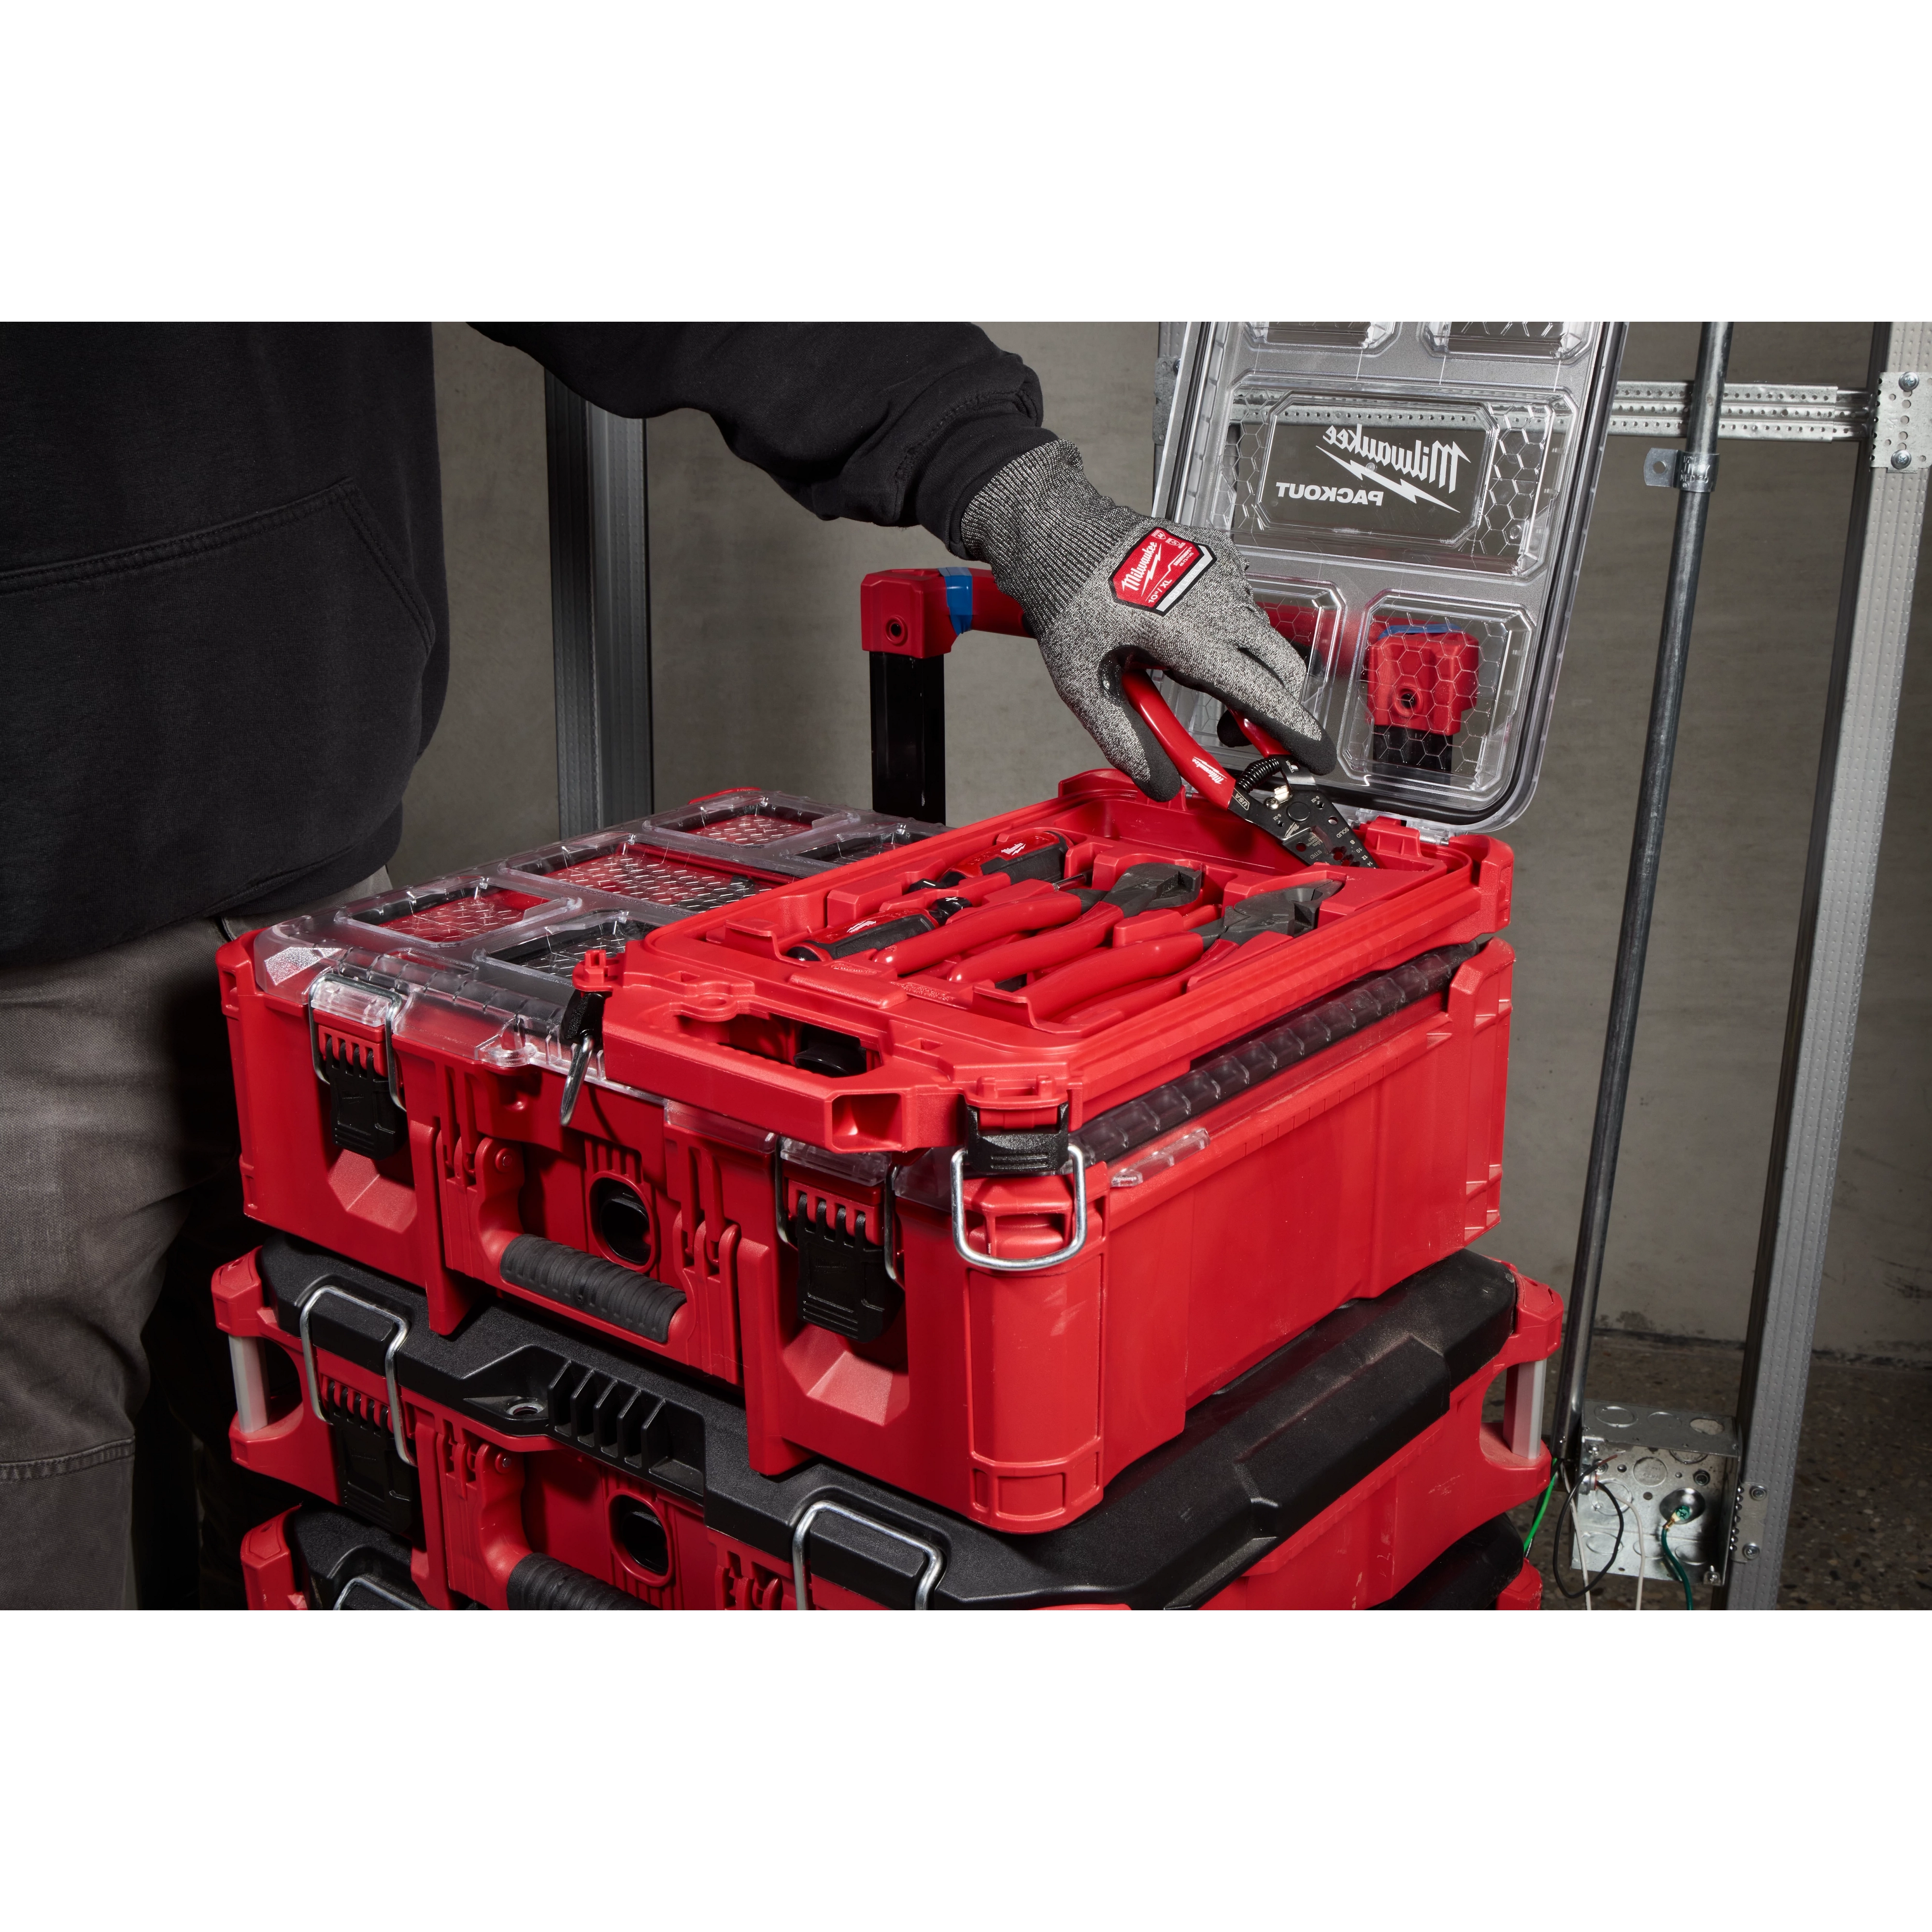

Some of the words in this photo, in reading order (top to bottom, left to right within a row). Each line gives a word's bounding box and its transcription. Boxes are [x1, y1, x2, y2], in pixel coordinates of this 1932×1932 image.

[1681, 463, 1710, 476] JIFY
[1122, 542, 1157, 591] Milwaukee
[1160, 579, 1173, 589] XL
[1168, 586, 1183, 600] CUT
[1182, 568, 1201, 586] LEVEL
[1192, 758, 1224, 784] Milwaukee
[1285, 760, 1294, 773] TETHER
[1235, 793, 1248, 807] USA
[1336, 827, 1350, 838] SOLID
[1001, 843, 1023, 854] Milwaukee
[1306, 838, 1318, 847] COPPER
[1310, 850, 1322, 859] STRD
